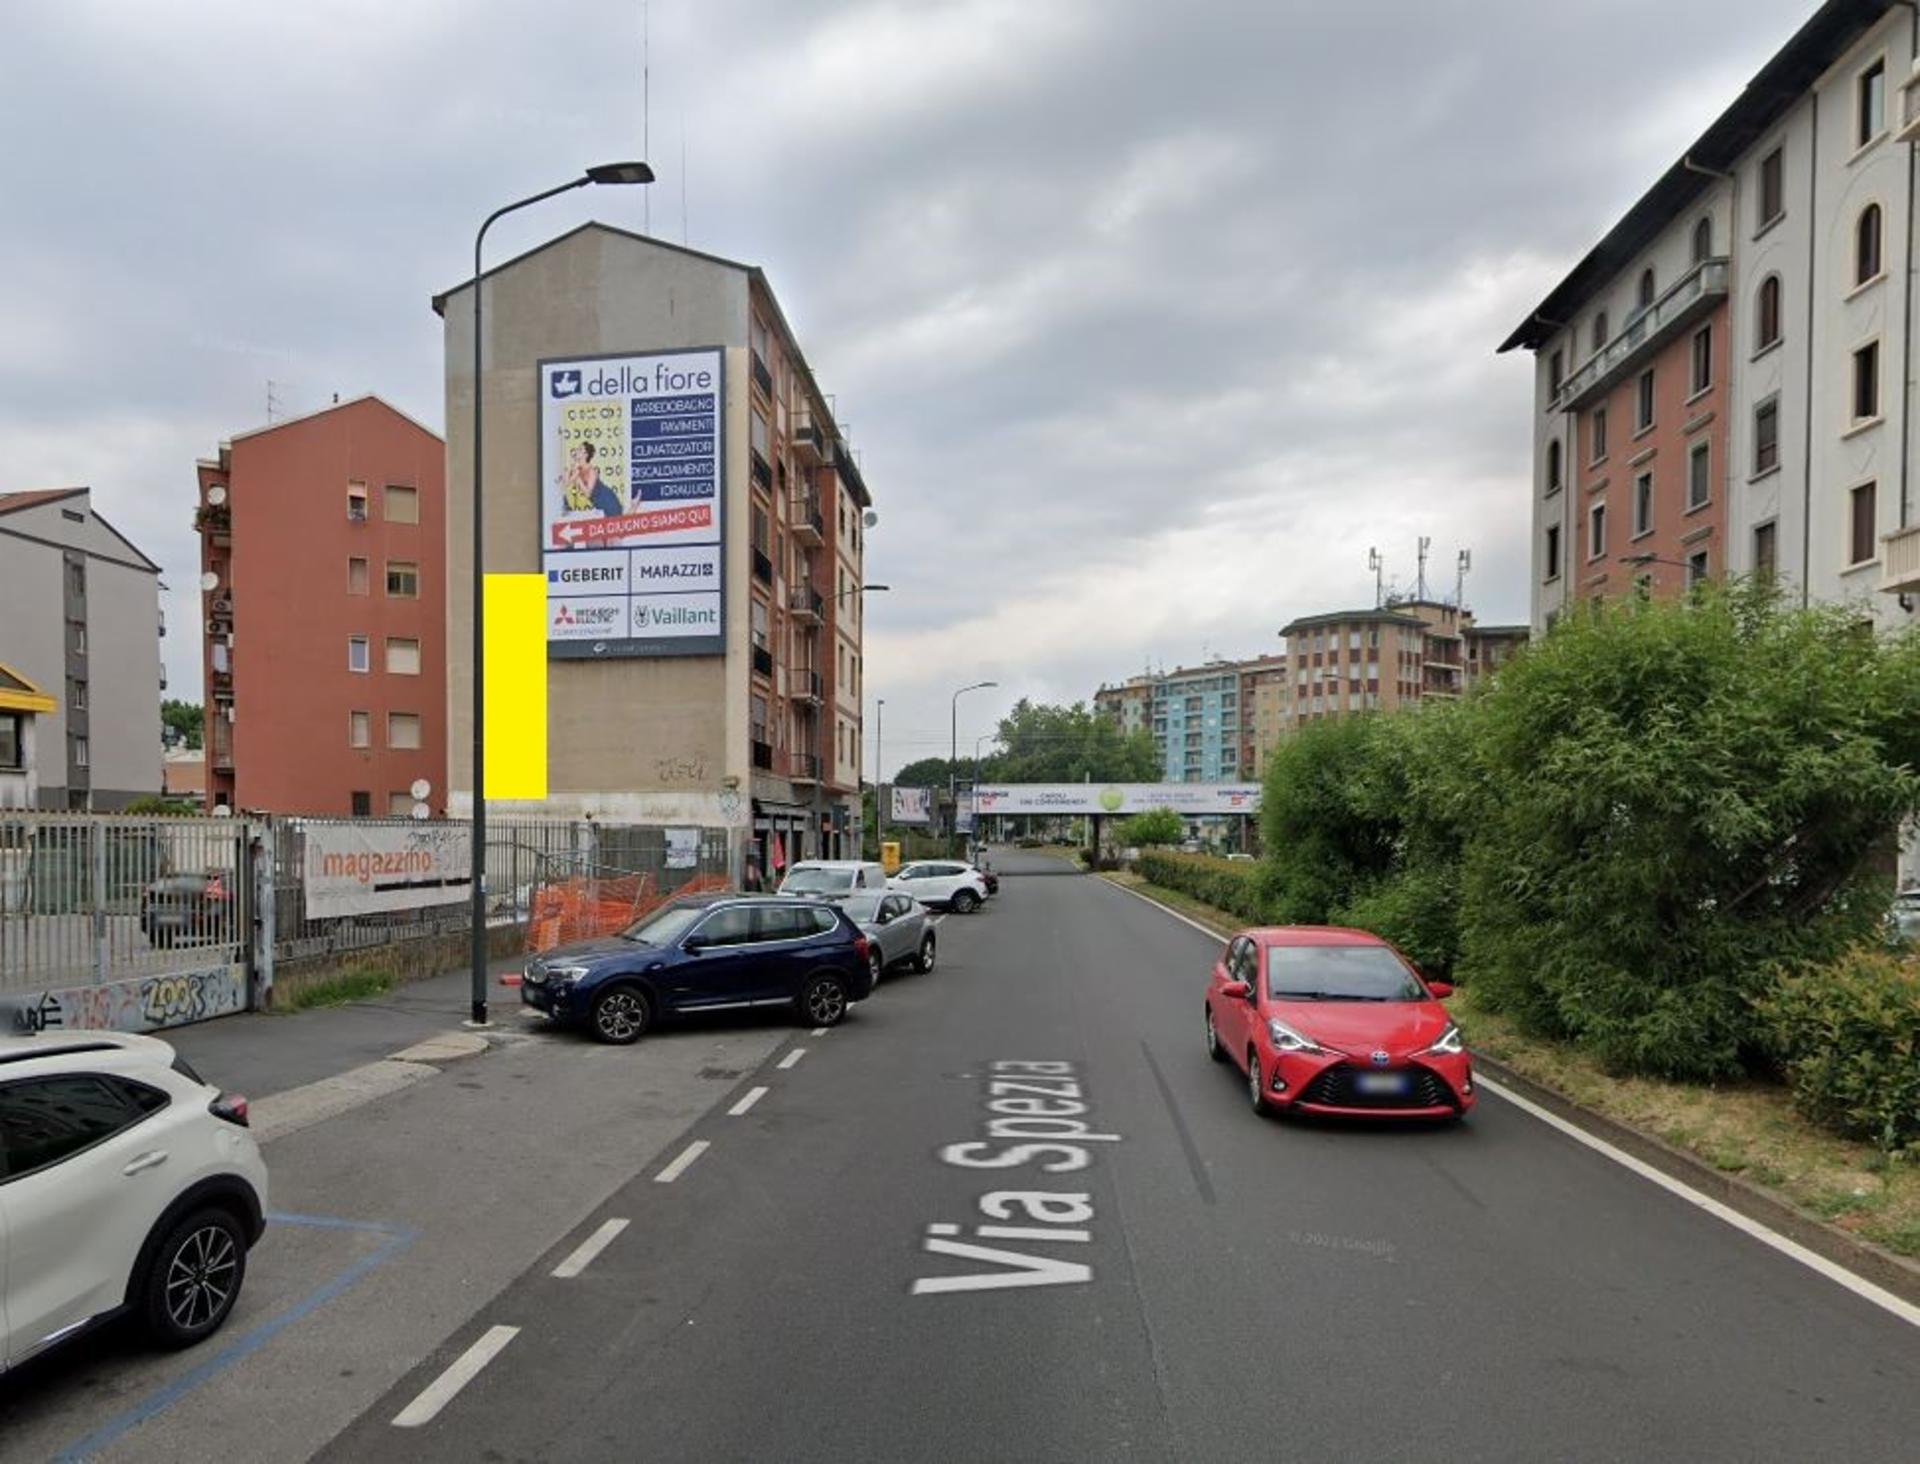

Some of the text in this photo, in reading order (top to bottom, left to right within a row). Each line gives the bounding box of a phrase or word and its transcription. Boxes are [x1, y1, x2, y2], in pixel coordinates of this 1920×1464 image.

[588, 363, 712, 396] della fiore
[633, 398, 714, 415] ARREDOBAGNO
[660, 419, 713, 433] PAVIMENTI
[633, 442, 713, 457] CLIMATIZZATORI
[631, 463, 714, 479] RISCALDAMENTO
[660, 482, 714, 497] IDRAULICA
[588, 509, 709, 537] DA GIUGNO SIAMO QUI
[560, 567, 624, 582] GEBERIT
[640, 563, 702, 579] MARAZZI
[651, 606, 717, 626] Vaillant
[323, 844, 433, 883] magazzino
